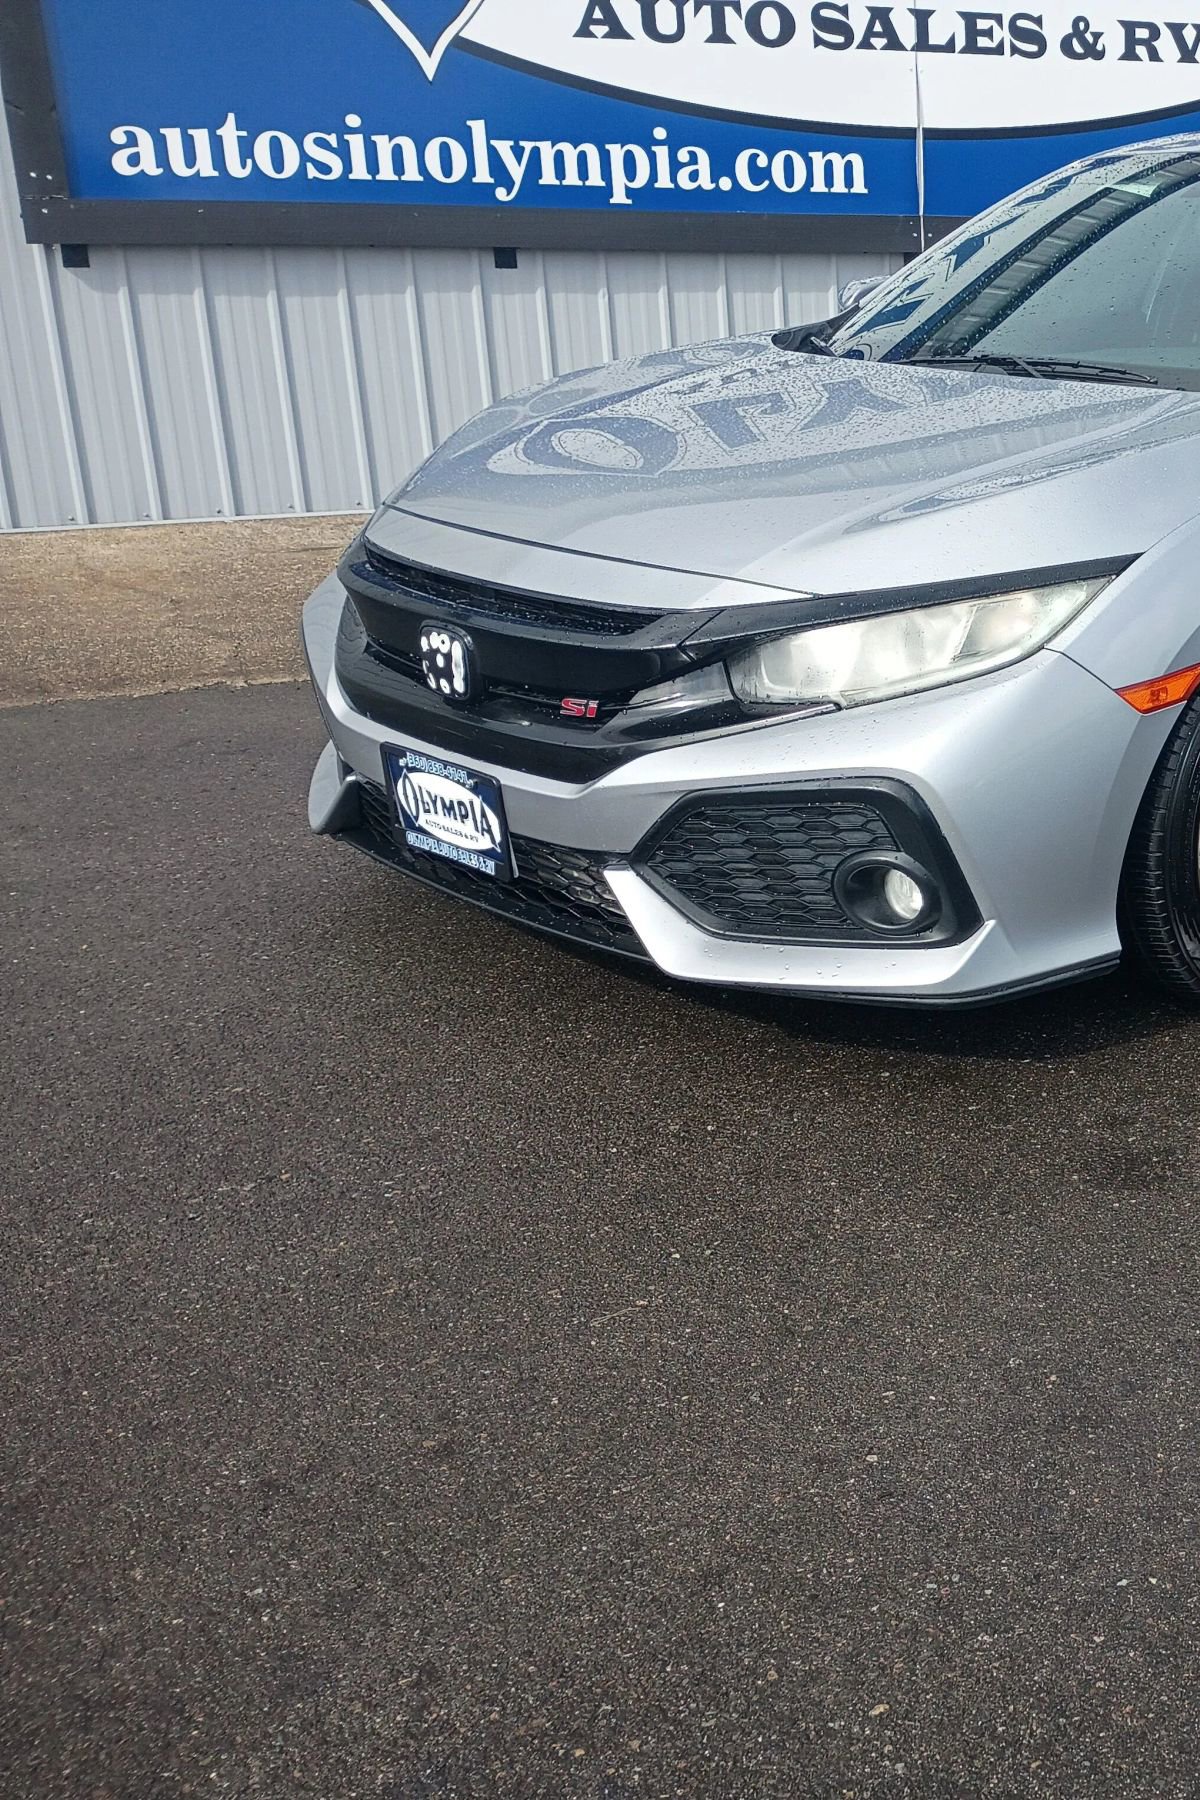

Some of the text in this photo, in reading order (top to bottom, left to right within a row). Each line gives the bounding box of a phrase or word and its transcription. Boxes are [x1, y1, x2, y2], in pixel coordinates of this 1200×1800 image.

[572, 0, 797, 48] AUTO
[811, 3, 1048, 60] SALES
[1059, 15, 1107, 61] &
[109, 113, 869, 205] autosinolympia.com
[560, 698, 599, 717] Si
[401, 768, 500, 852] OLYMPIA
